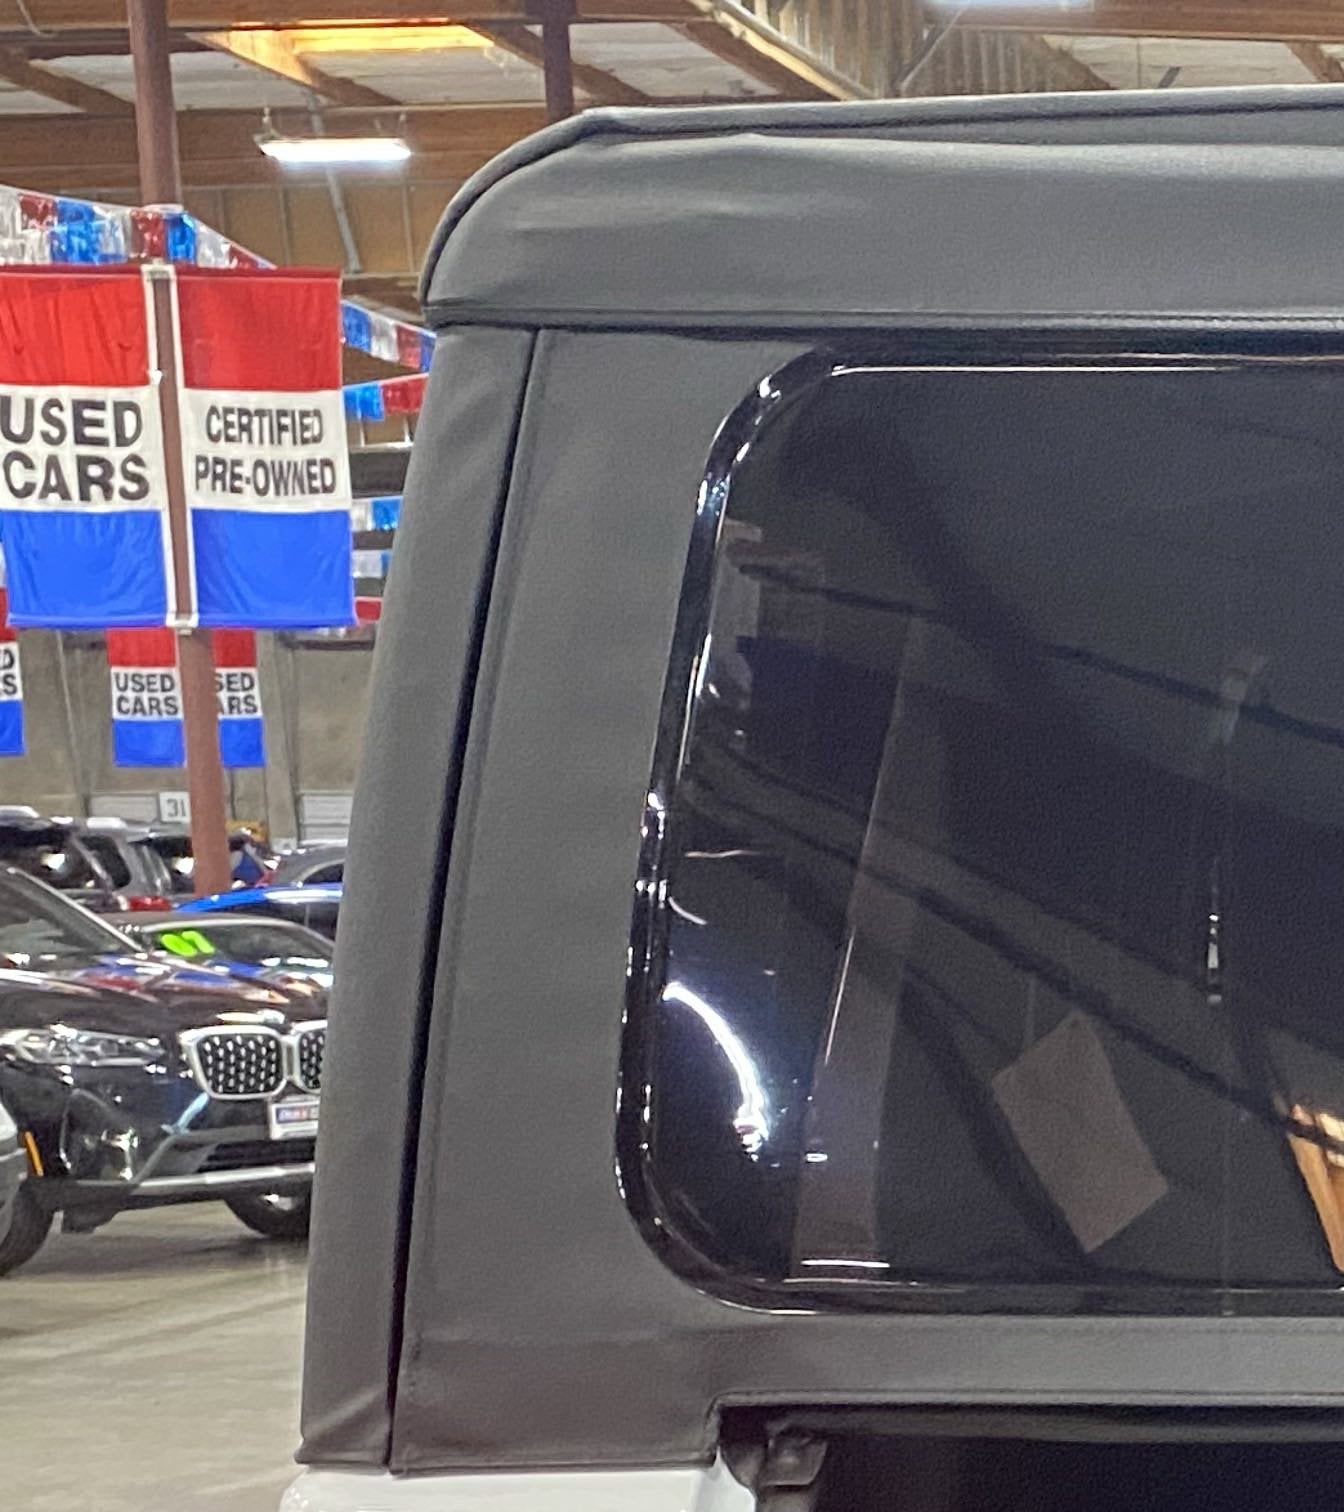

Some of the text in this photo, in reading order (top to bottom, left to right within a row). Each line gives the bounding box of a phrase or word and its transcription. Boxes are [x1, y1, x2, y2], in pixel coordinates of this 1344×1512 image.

[1, 395, 142, 447] USED
[205, 405, 323, 446] CERTIFIED
[2, 451, 151, 501] CARS
[194, 455, 336, 498] PRE-OWNED
[114, 672, 176, 693] USED
[215, 672, 255, 692] SED
[116, 695, 179, 716] CARS
